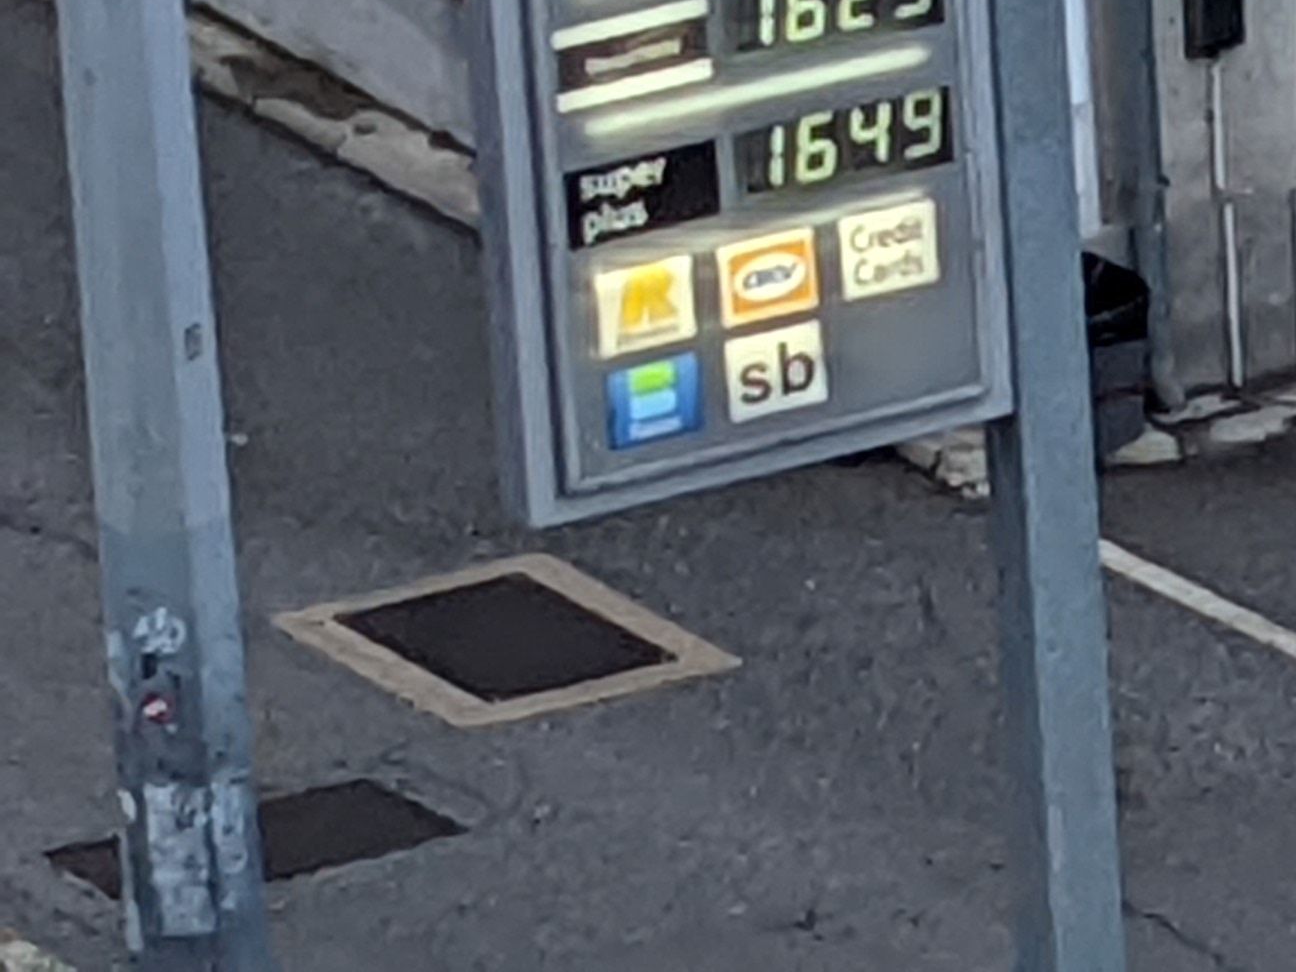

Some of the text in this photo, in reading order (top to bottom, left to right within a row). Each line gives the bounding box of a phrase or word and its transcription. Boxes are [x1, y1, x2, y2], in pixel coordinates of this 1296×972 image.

[579, 87, 943, 202] super 1649
[581, 200, 649, 245] plus
[738, 341, 815, 405] sb
